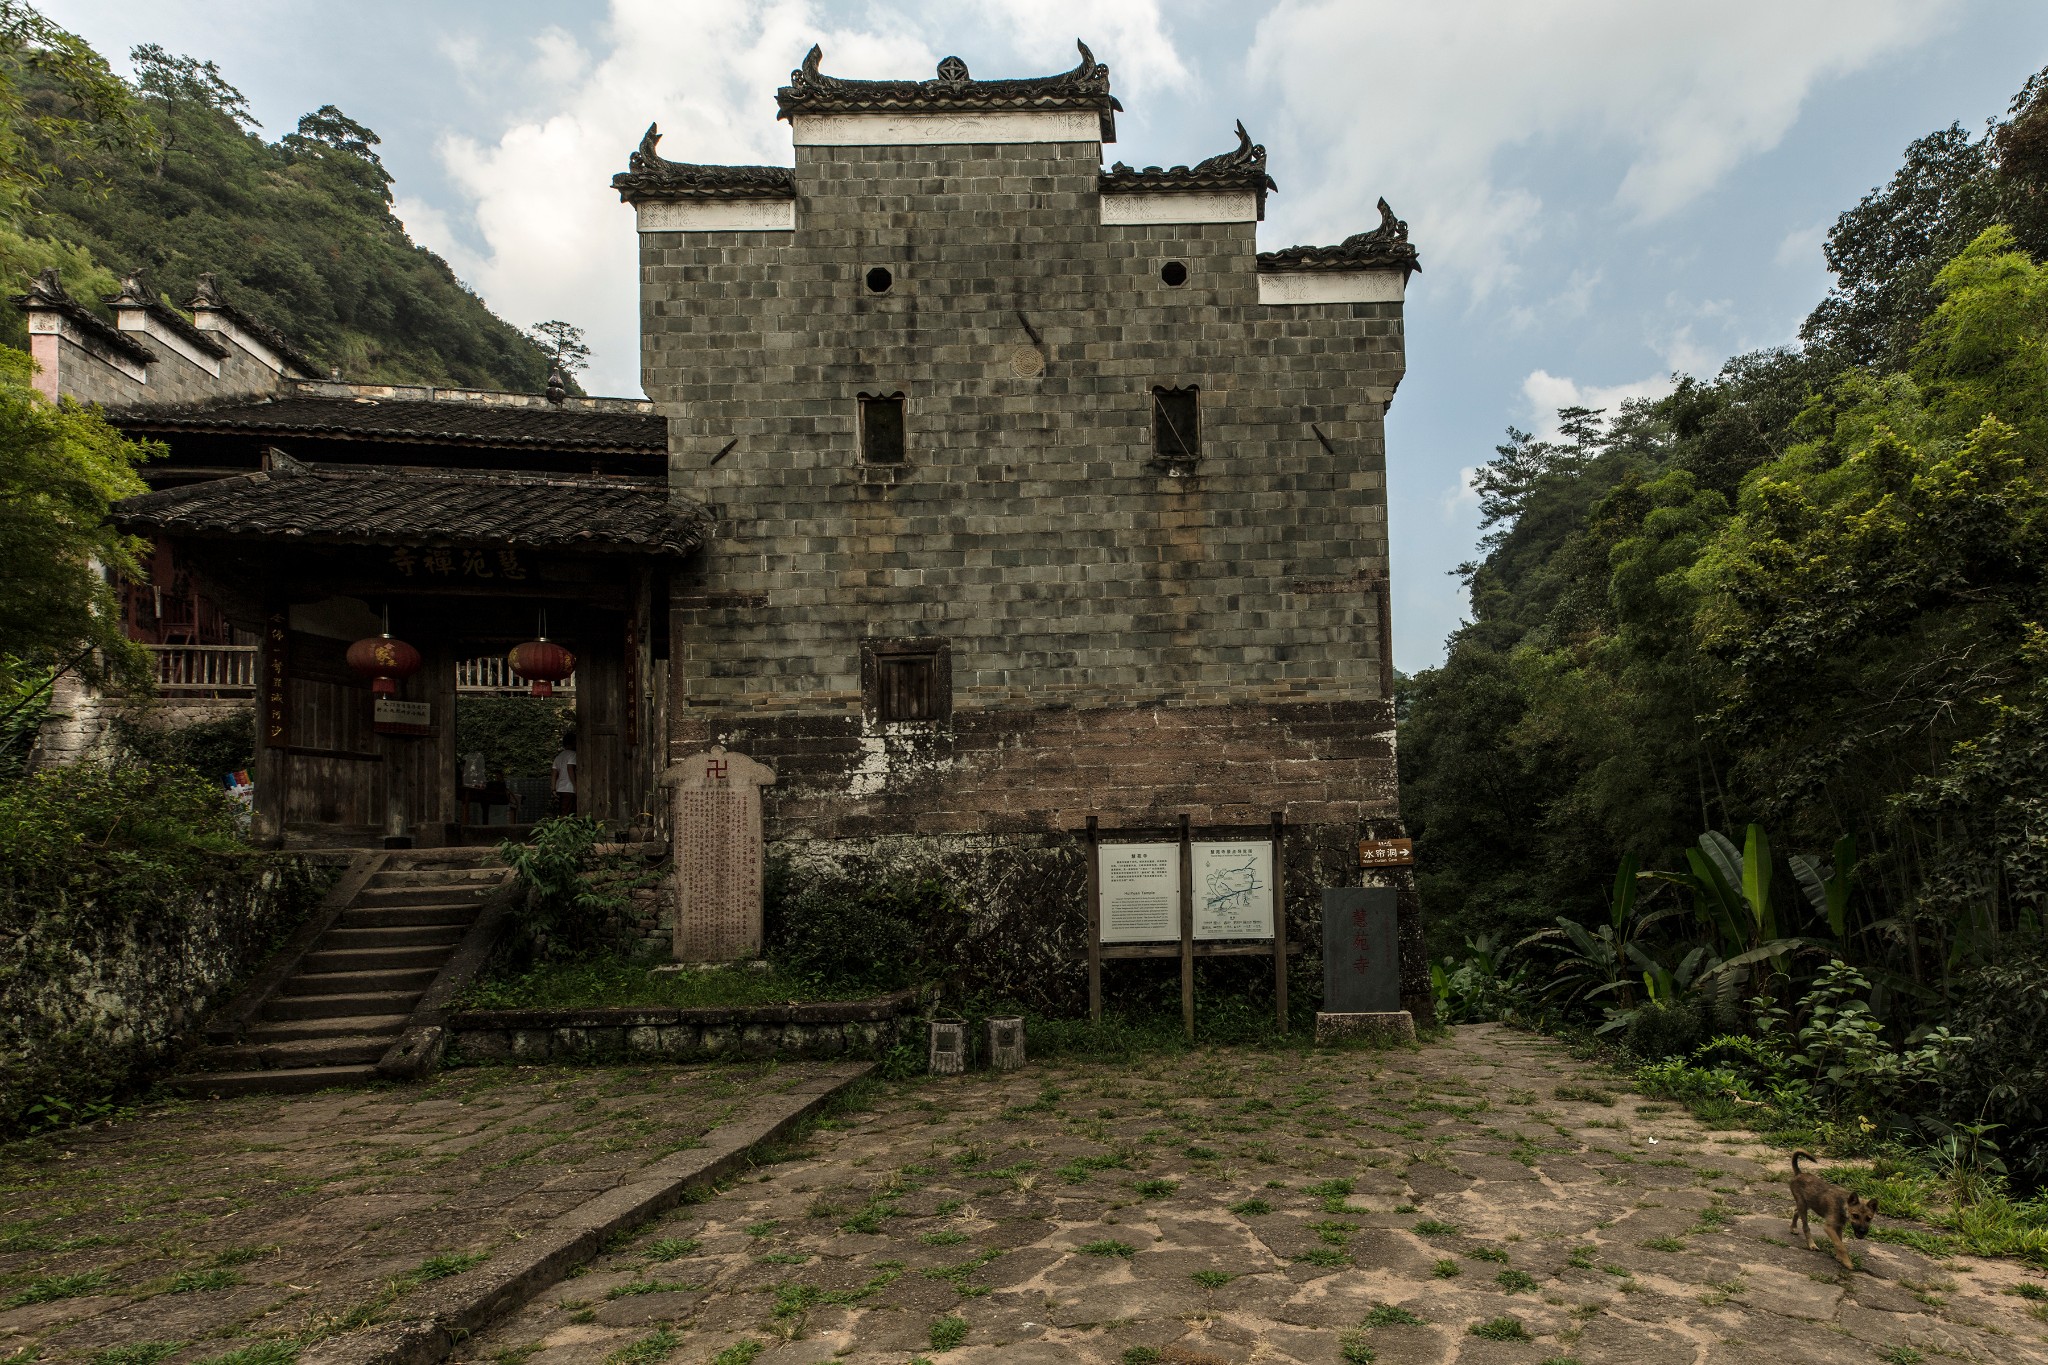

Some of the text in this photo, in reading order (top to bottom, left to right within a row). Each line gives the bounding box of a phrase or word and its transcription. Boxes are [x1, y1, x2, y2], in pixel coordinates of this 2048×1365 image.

[1364, 848, 1397, 859] 水帘洞
[1352, 908, 1370, 975] 慧苑寺
